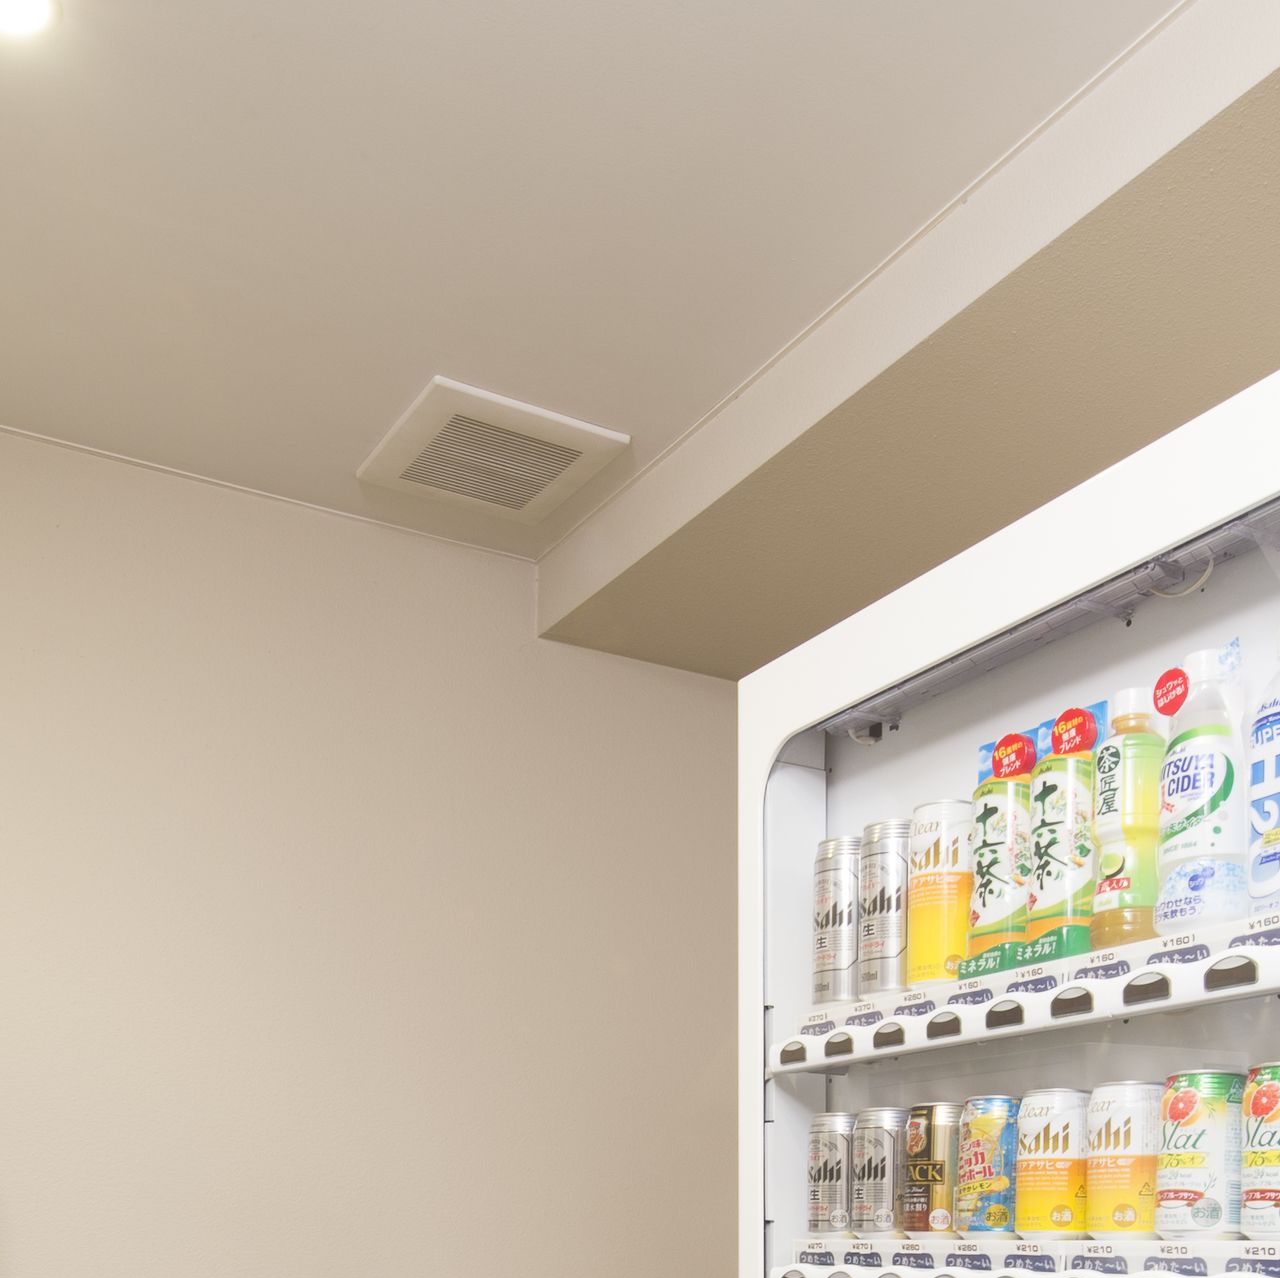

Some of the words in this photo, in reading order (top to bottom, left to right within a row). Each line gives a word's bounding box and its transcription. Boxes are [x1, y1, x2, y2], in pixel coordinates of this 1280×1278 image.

[912, 821, 942, 836] lear
[1031, 781, 1068, 890] 十六茶
[910, 836, 959, 874] sahi
[974, 803, 1008, 908] 十六茶
[860, 886, 902, 919] sahi
[814, 901, 852, 932] sahi
[1249, 917, 1280, 930] ¥160
[863, 924, 875, 937] 生
[1162, 937, 1190, 947] ¥160
[1090, 952, 1115, 963] ¥160
[1019, 1122, 1070, 1156] sahi
[1088, 1116, 1131, 1152] sahi
[1161, 1120, 1207, 1151] Slat
[809, 1158, 841, 1183] sahi
[853, 1156, 886, 1181] sahi
[908, 1165, 942, 1181] ACK
[1193, 1206, 1220, 1220] お酒
[1087, 1246, 1112, 1254] ¥210
[1160, 1246, 1188, 1256] ¥210
[1245, 1247, 1276, 1257] ¥210
